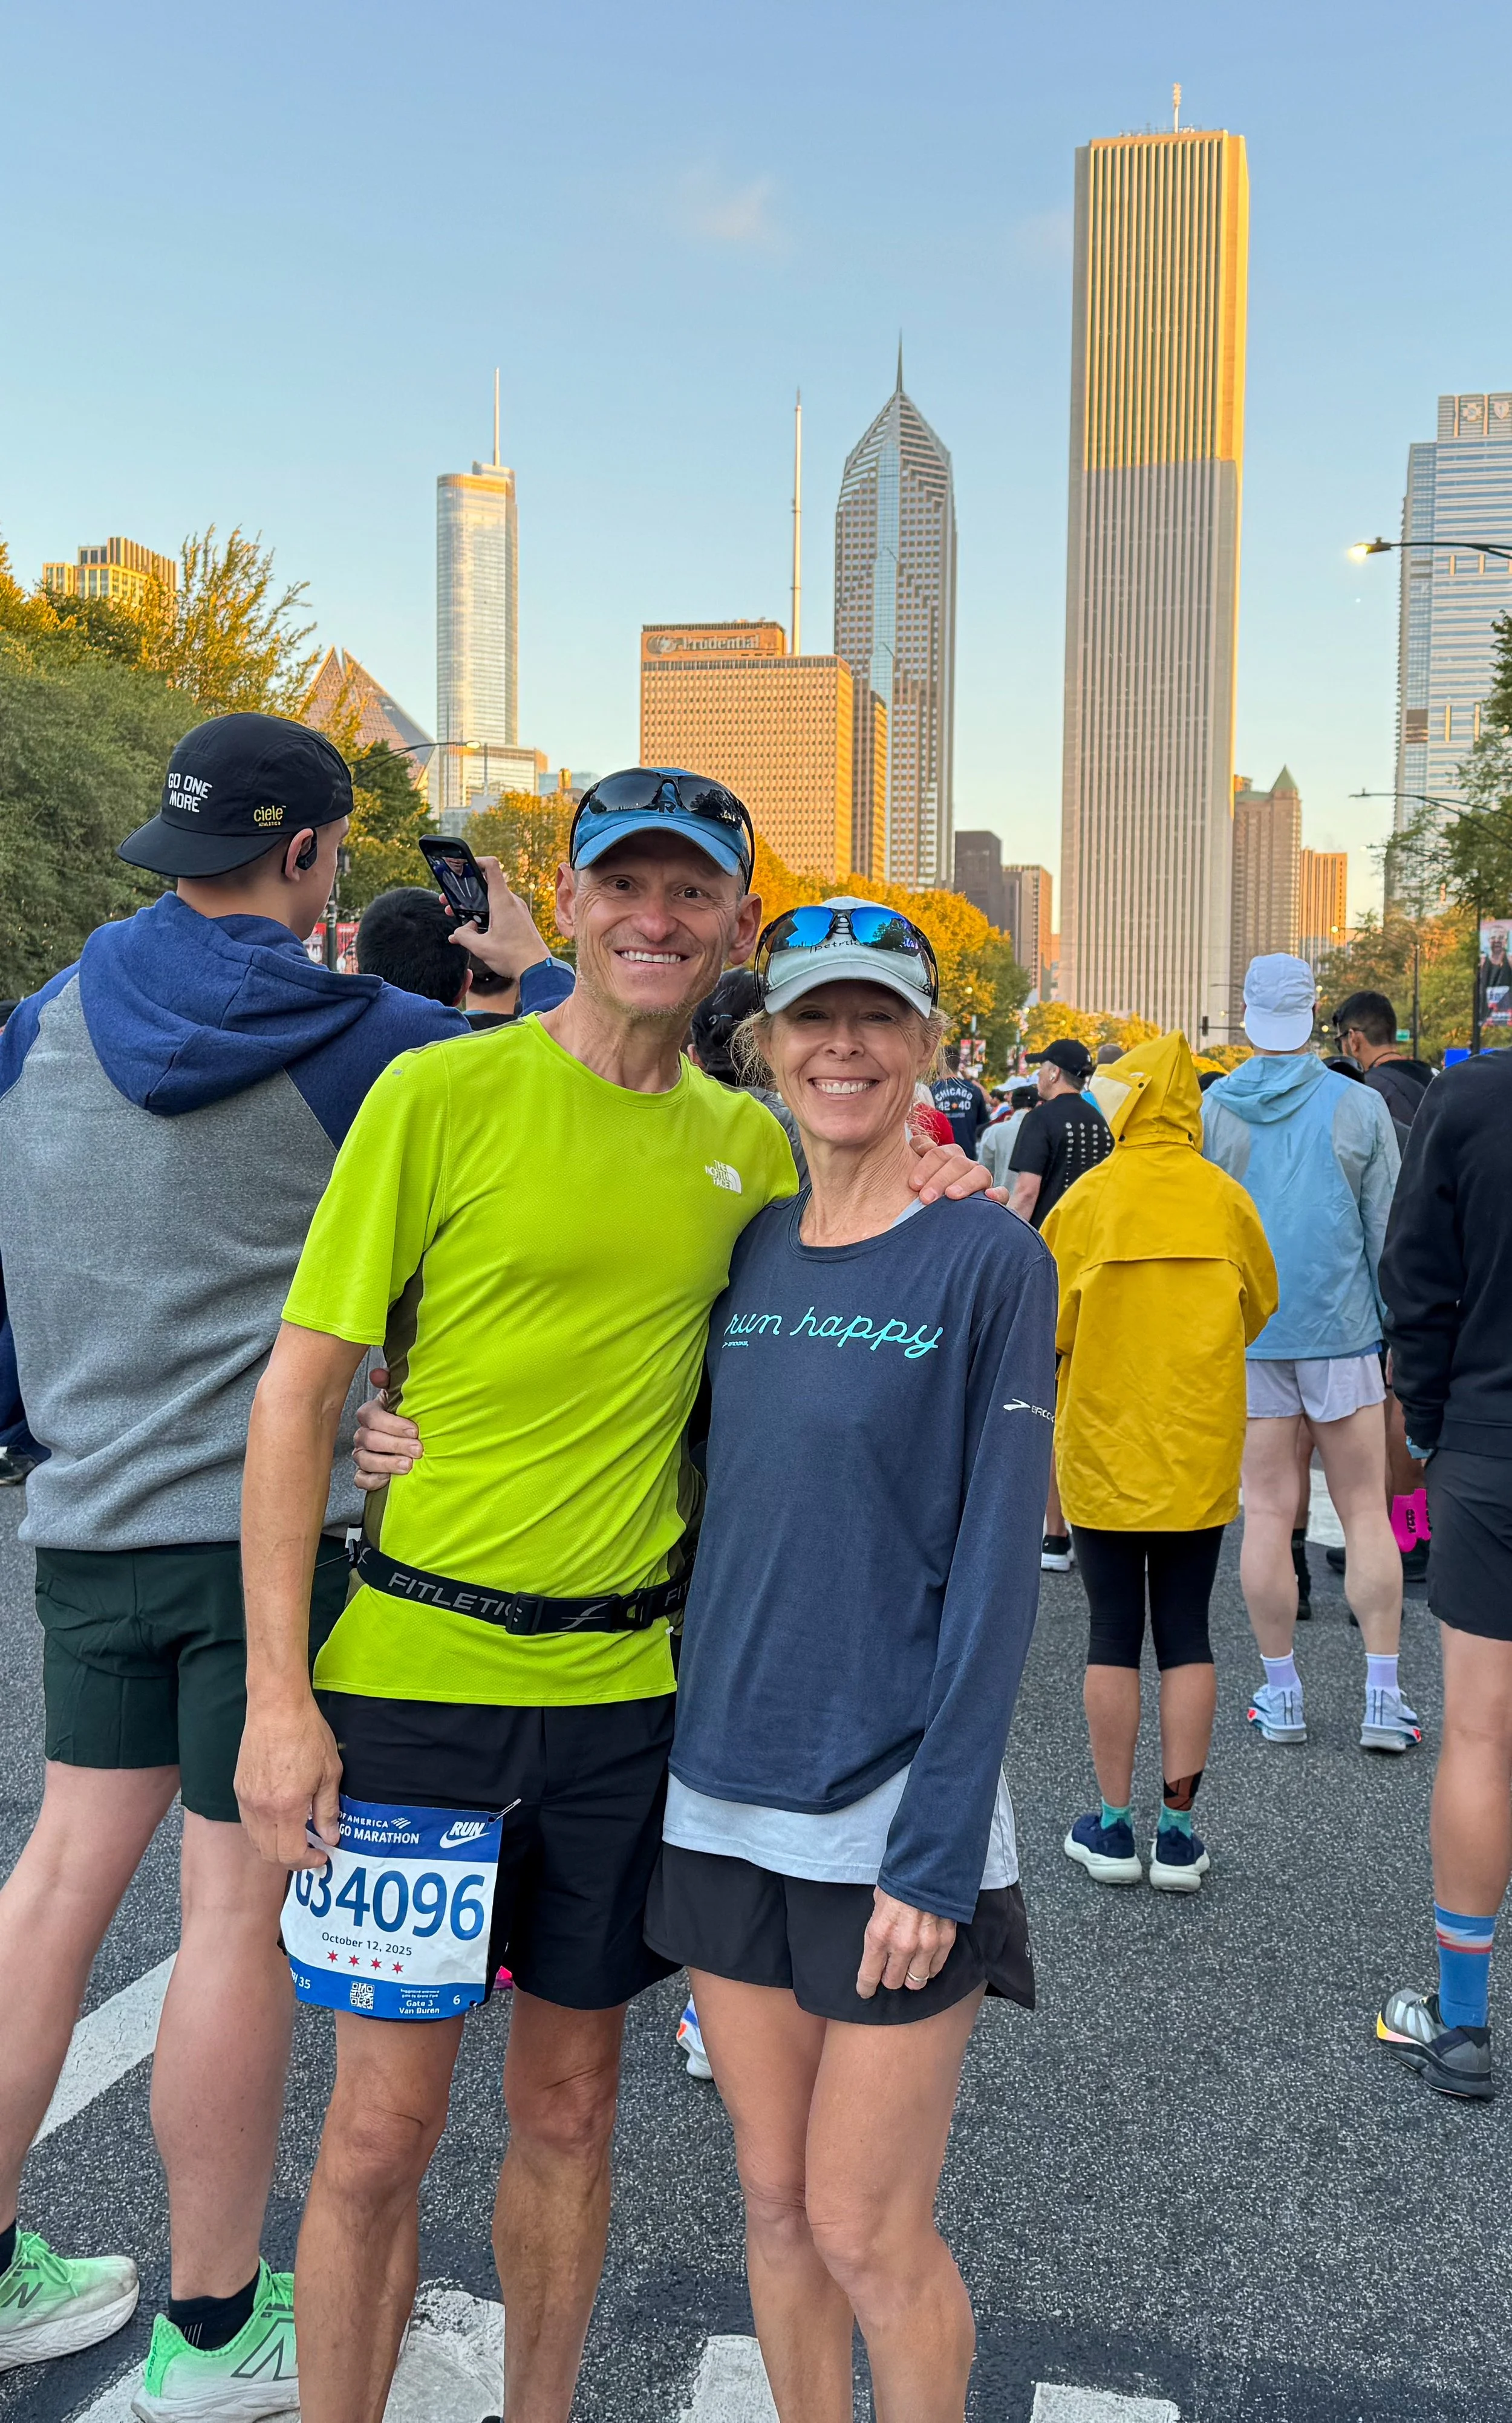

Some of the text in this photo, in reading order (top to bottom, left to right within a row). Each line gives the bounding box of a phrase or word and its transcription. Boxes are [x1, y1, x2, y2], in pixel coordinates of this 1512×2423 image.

[682, 634, 760, 650] Prudential
[168, 773, 212, 798] GO ONE
[169, 790, 201, 813] MORE
[253, 805, 283, 822] ciele
[934, 1088, 973, 1101] CHICAGO
[936, 1101, 971, 1110] 42 40
[723, 1306, 943, 1359] run happy
[347, 1815, 388, 1828] AMERICA
[449, 1821, 485, 1836] RUN
[354, 1827, 420, 1844] MARATHON
[322, 1932, 412, 1955] October 12, 2025
[453, 1995, 460, 2005] 6
